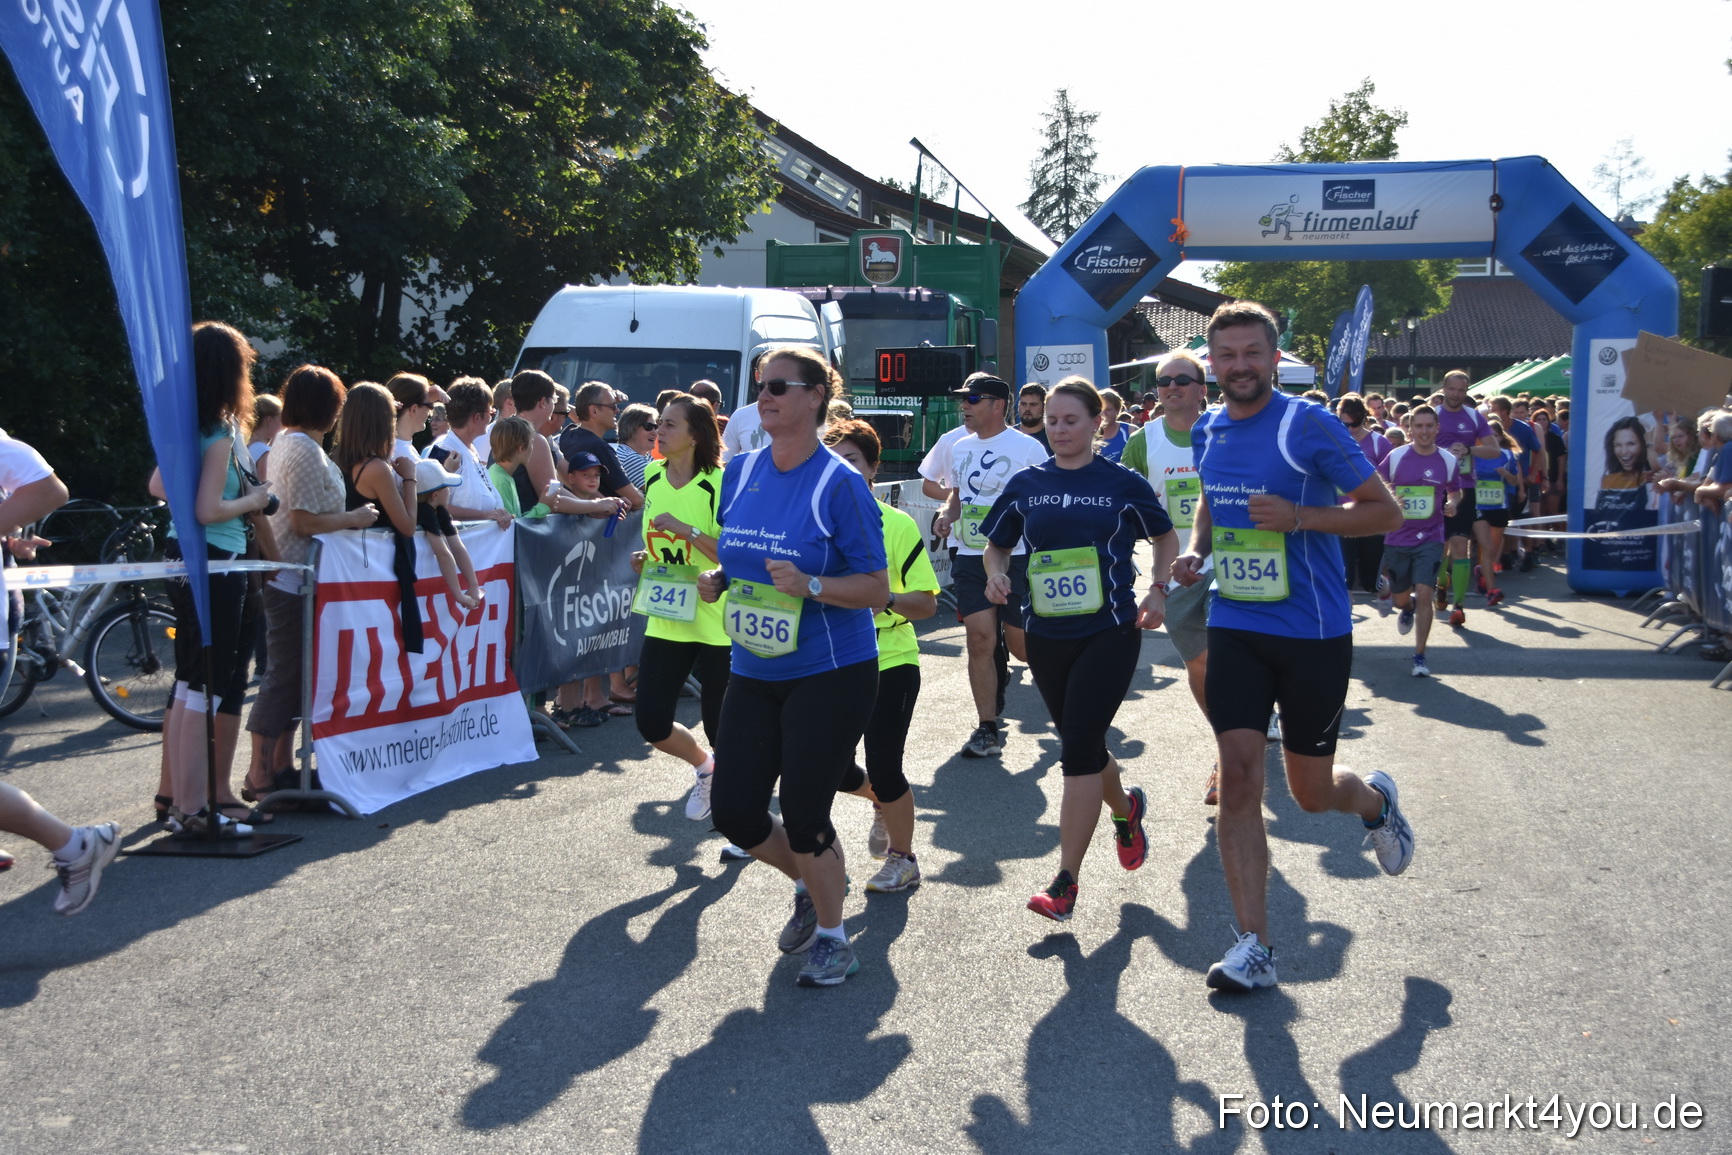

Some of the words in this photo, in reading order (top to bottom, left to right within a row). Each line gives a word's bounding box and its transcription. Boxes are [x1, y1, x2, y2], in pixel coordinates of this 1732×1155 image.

[1333, 190, 1372, 199] Fischer
[1303, 208, 1420, 231] firmenlauf
[1302, 232, 1350, 241] neumarkt
[1086, 255, 1146, 269] Fischer
[871, 272, 890, 281] 1628
[1241, 483, 1267, 495] kommt
[1478, 489, 1500, 498] 1115
[1028, 494, 1061, 507] EURO
[1073, 496, 1112, 507] POLES
[1213, 496, 1234, 507] jeder
[1235, 498, 1249, 506] nac
[1403, 499, 1426, 510] 513
[760, 526, 787, 540] kommt
[722, 538, 747, 549] jeder
[747, 542, 768, 551] nach
[1219, 556, 1279, 582] 1354
[1043, 574, 1087, 599] 366
[649, 585, 688, 608] 341
[563, 579, 638, 631] Fischer
[730, 609, 790, 643] 1356
[576, 627, 631, 657] AUTOMOBILE
[312, 578, 511, 724] MEIER
